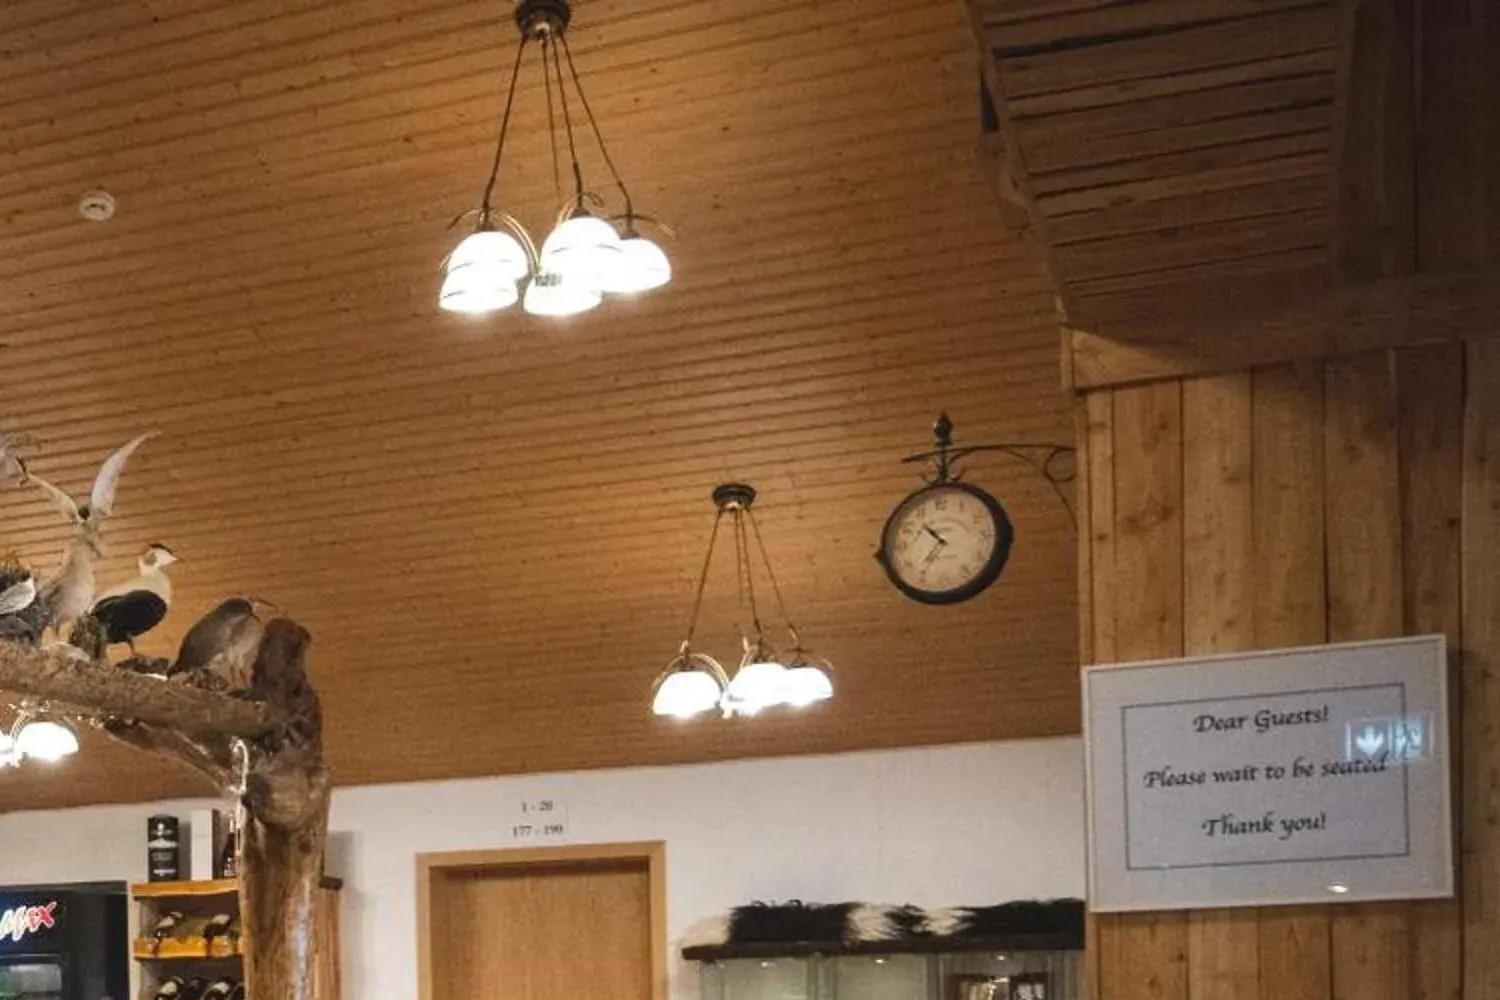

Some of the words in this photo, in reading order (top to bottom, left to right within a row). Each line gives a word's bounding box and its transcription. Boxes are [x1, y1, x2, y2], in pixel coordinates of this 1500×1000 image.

[1193, 712, 1248, 733] Dear
[1253, 704, 1329, 732] Guests!
[1143, 763, 1206, 787] Please
[1212, 765, 1259, 784] wait
[1264, 763, 1286, 781] to
[1292, 756, 1315, 778] be
[1321, 750, 1389, 775] seated
[1202, 811, 1274, 837] Thank
[1279, 813, 1326, 839] you!
